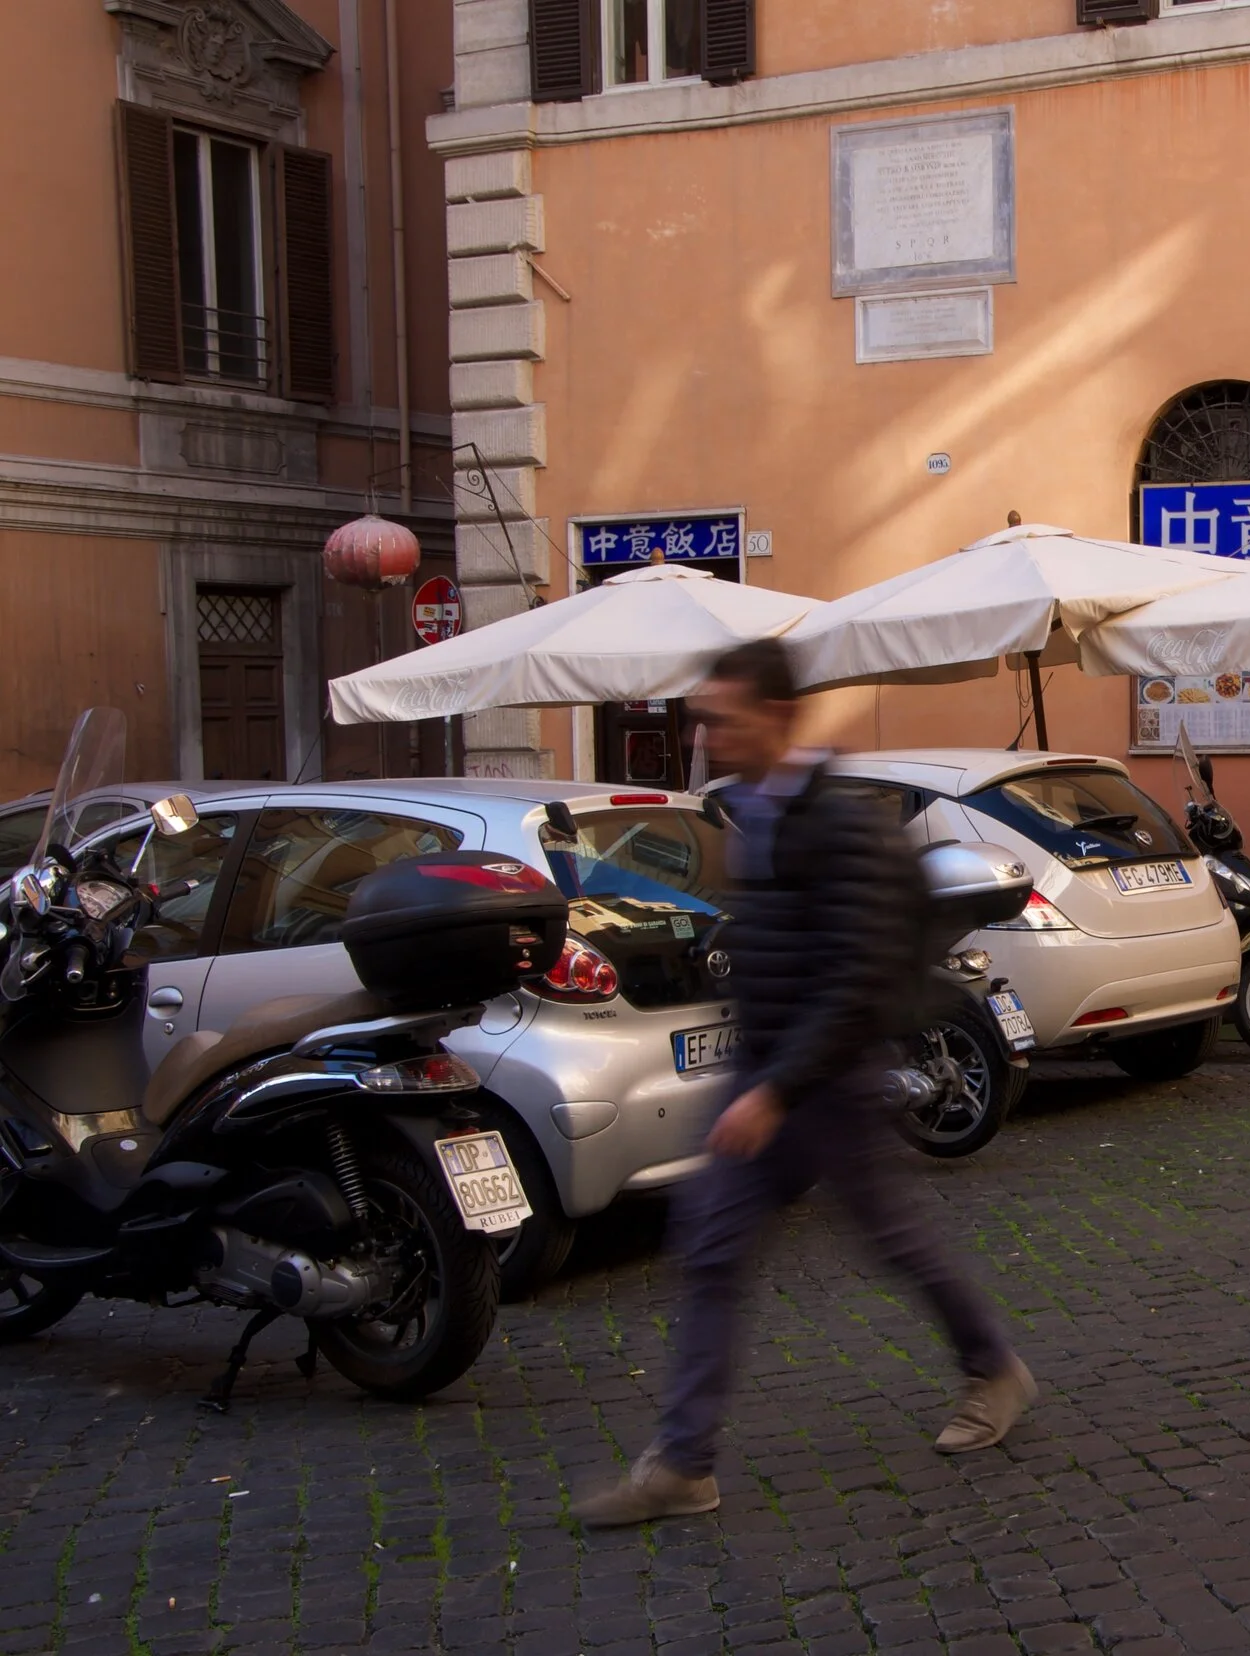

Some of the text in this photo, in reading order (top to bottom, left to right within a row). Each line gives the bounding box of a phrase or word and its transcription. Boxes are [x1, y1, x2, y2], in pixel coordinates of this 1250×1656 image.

[588, 520, 737, 561] 中意飯店
[748, 534, 769, 553] 50
[1146, 863, 1184, 884] 479ME
[1001, 1014, 1031, 1037] 70784
[688, 1033, 708, 1065] EF
[455, 1143, 480, 1171] DP
[459, 1172, 519, 1209] 80662
[480, 1210, 521, 1228] RUBEI
